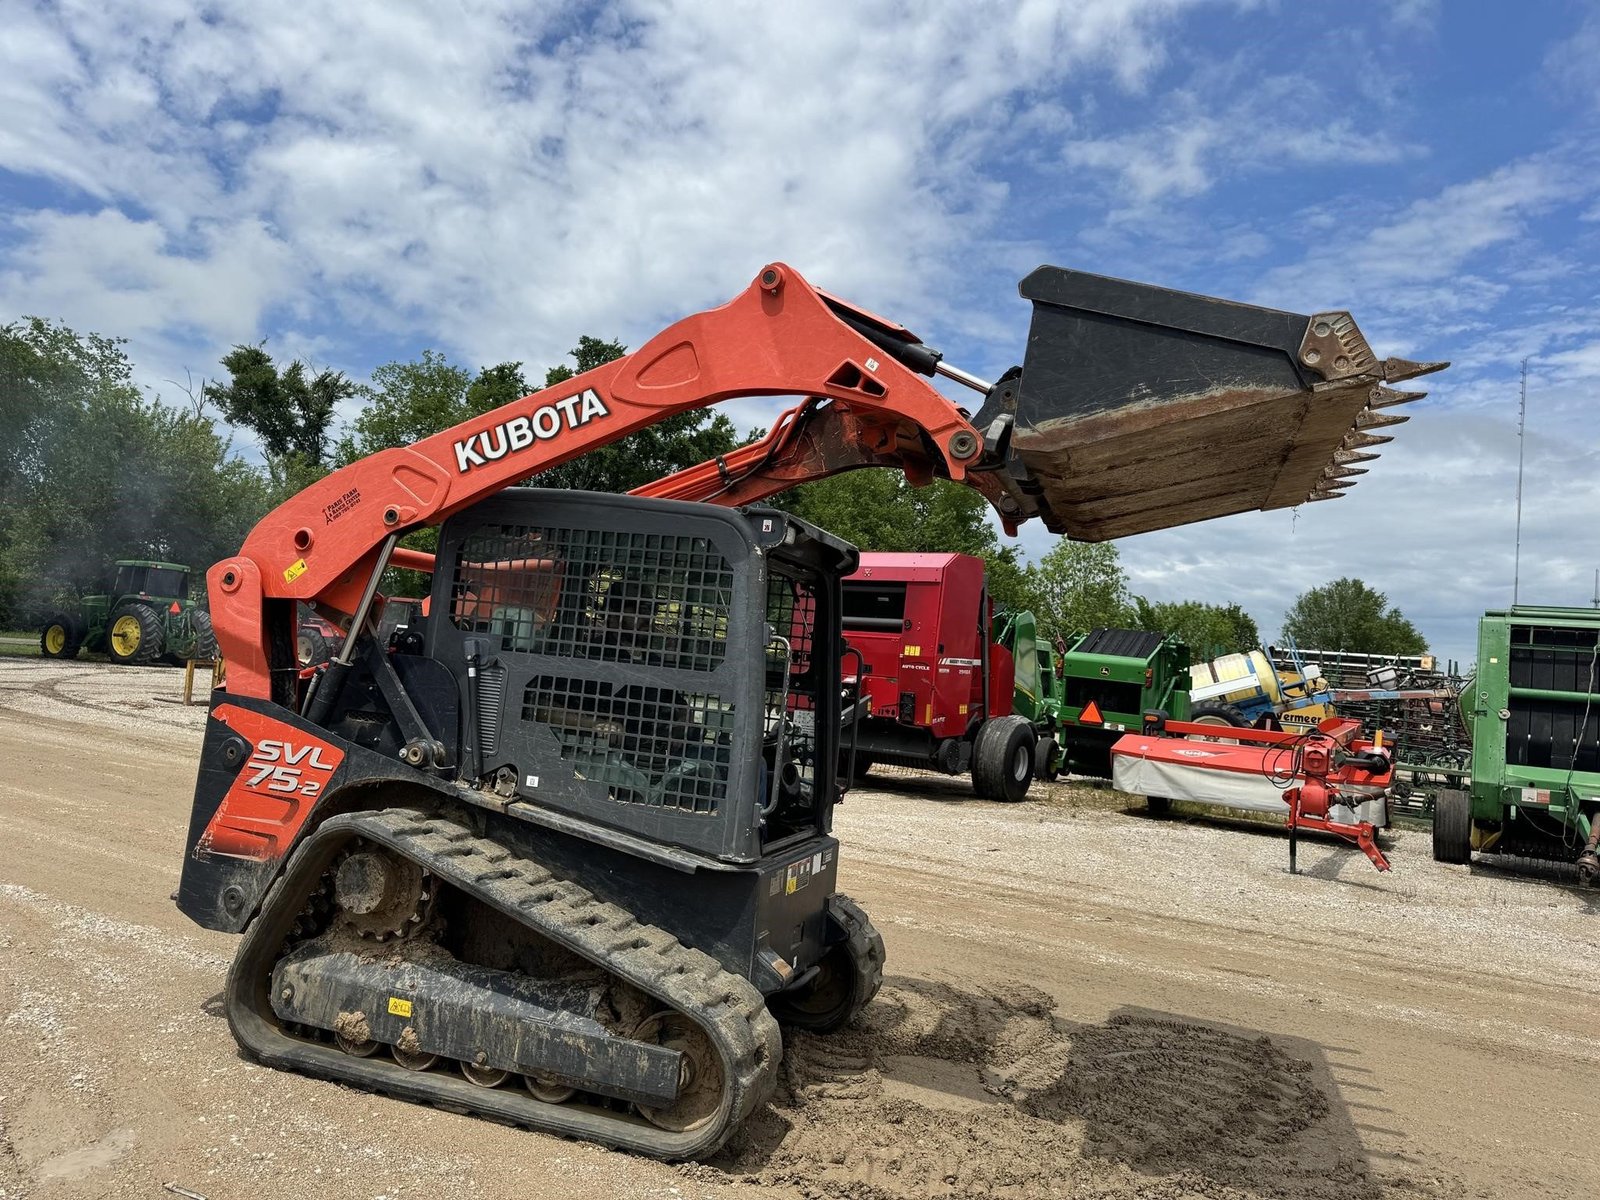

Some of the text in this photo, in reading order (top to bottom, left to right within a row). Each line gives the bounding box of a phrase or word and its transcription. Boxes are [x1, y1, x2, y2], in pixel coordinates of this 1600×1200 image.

[453, 388, 609, 473] KUBOTA
[342, 488, 357, 501] FARM
[1276, 712, 1322, 724] Vermeer
[253, 739, 333, 770] SVL
[246, 762, 321, 796] 75-2
